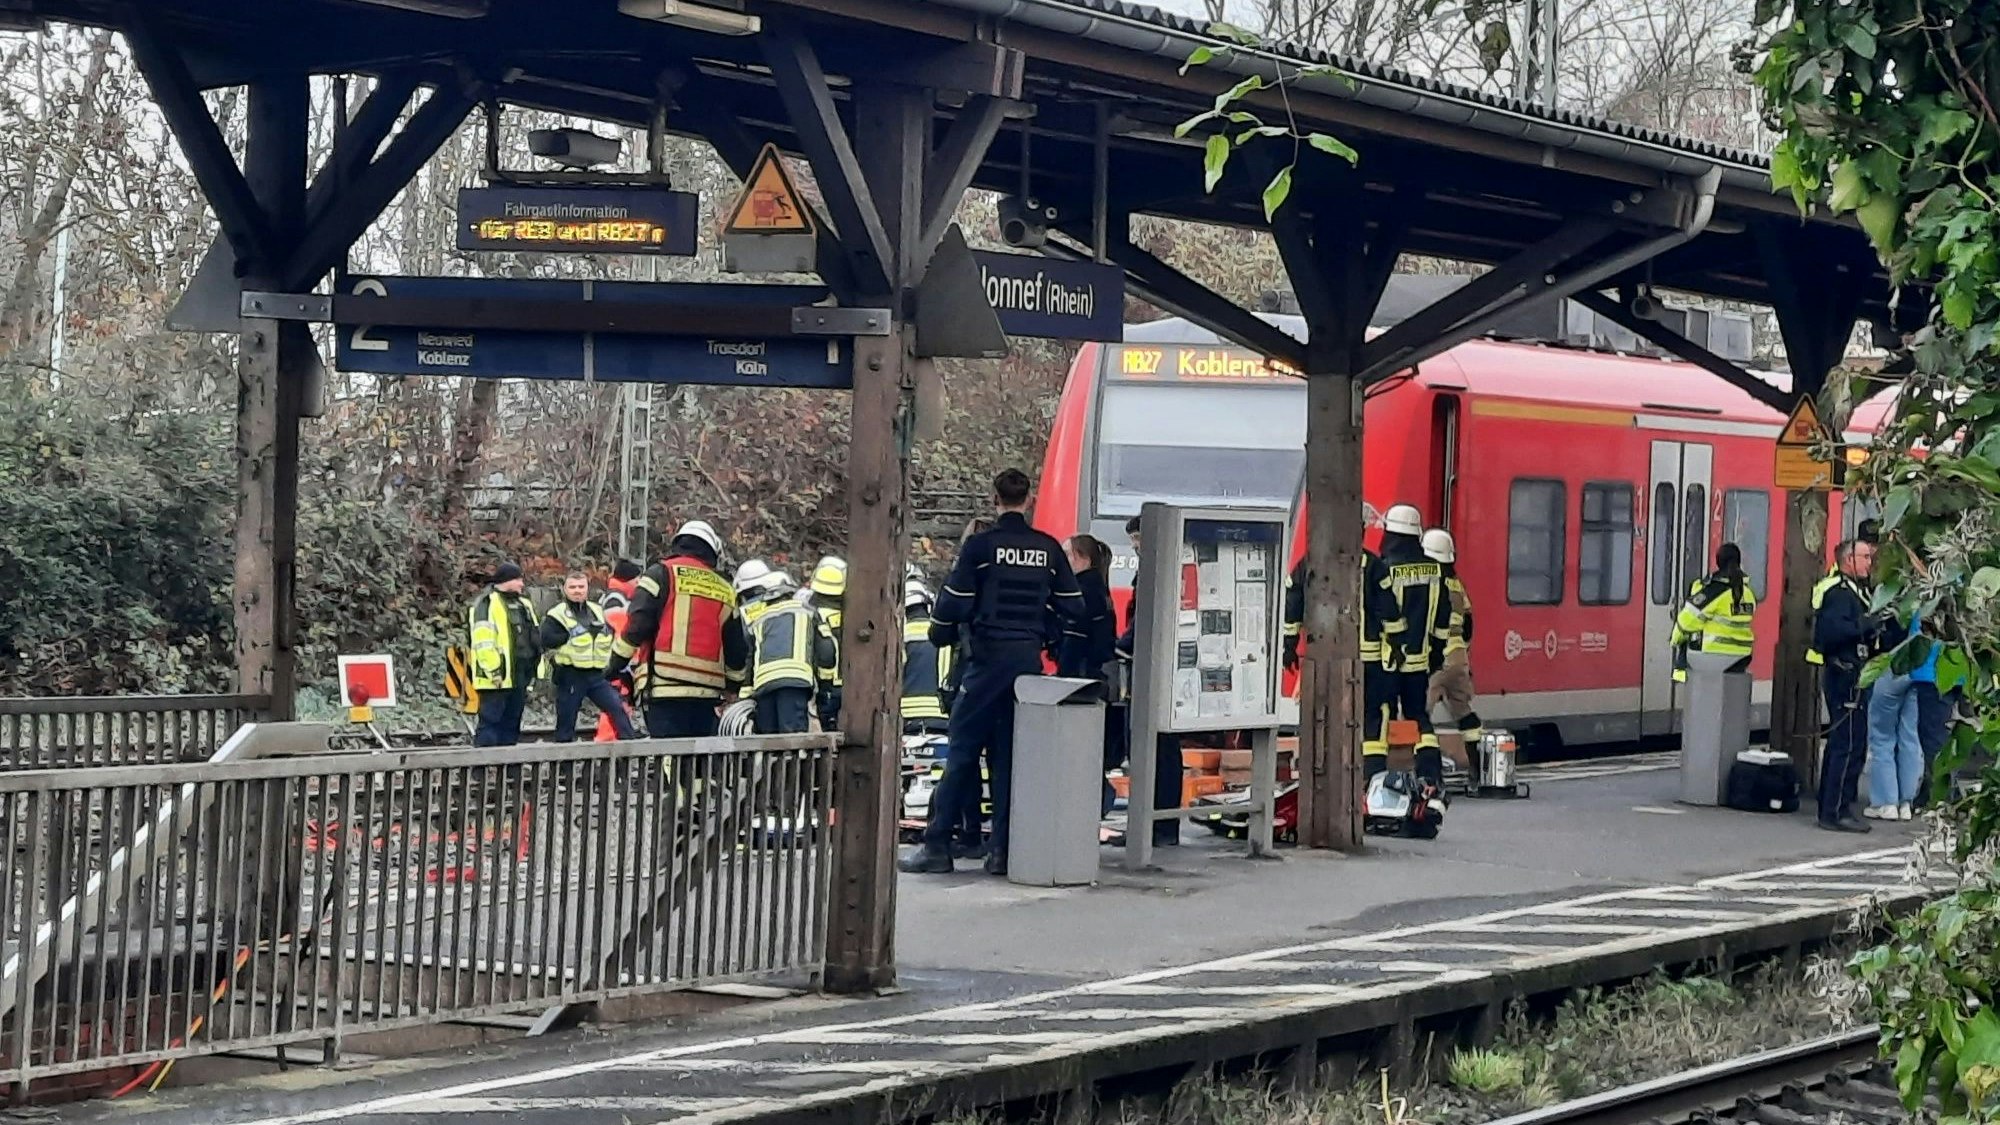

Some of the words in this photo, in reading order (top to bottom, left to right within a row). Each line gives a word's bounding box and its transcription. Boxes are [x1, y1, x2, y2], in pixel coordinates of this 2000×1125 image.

[505, 202, 628, 219] Fahrgastinformation
[556, 224, 597, 242] und
[597, 222, 650, 242] RB27
[1046, 279, 1092, 318] (Rhein)
[707, 339, 765, 355] Troisdorf
[417, 350, 470, 366] Koblenz
[736, 359, 767, 376] Köln
[1123, 350, 1162, 374] RB27
[1713, 487, 1722, 521] 2
[996, 548, 1047, 567] POLIZEI
